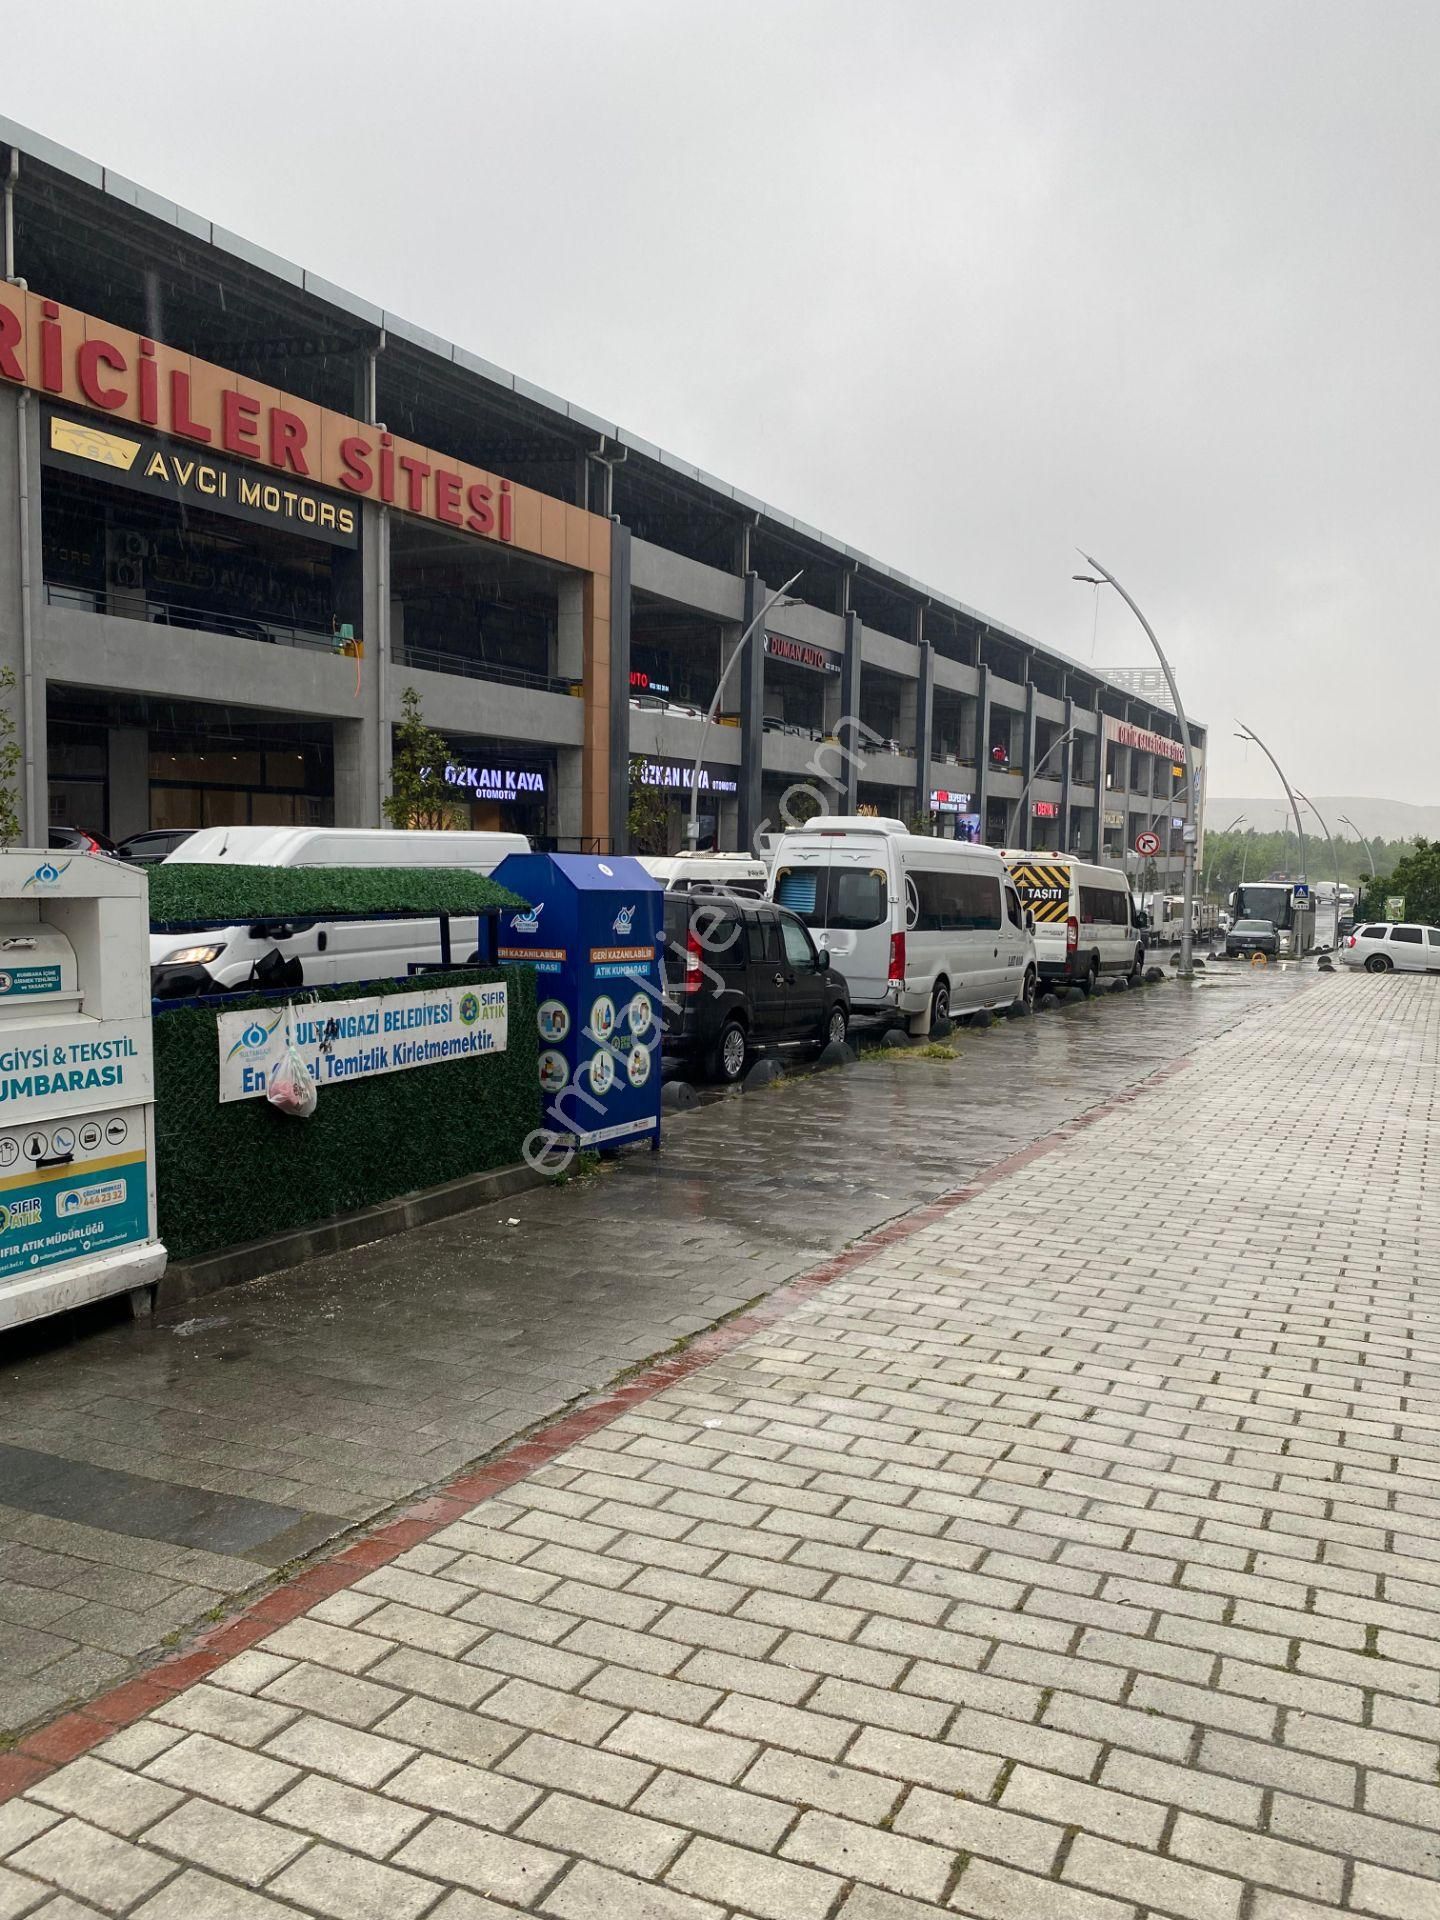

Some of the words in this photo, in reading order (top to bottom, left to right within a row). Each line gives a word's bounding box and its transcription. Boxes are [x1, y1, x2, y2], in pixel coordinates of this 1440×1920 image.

[144, 451, 227, 497] AVCI
[239, 478, 354, 533] MOTORS
[340, 433, 512, 541] SİTESİ
[771, 638, 801, 660] DUMAN
[803, 647, 824, 667] AUTO
[444, 761, 502, 788] ÖZKAN
[506, 770, 544, 791] KAYA
[476, 788, 517, 800] OTOMOTİV
[1028, 889, 1062, 900] TAŞITI
[510, 949, 563, 959] KAZANILABİLİR
[592, 949, 607, 960] GERİ
[608, 948, 652, 959] KAZANILABİLİR
[596, 967, 610, 976] ATIK
[612, 965, 647, 975] KUMBARASI
[481, 991, 505, 1006] SIFIR
[384, 999, 452, 1032] BELEDİYESİ
[482, 1005, 505, 1020] ATIK
[0, 1044, 48, 1072] GİYSİ
[53, 1046, 66, 1066] &
[69, 1035, 138, 1062] TEKSTİL
[243, 1067, 266, 1093] En
[325, 1046, 388, 1078] Temizlik
[393, 1029, 494, 1065] Kirletmemektir.
[101, 1192, 111, 1203] 23
[11, 1199, 41, 1215] SIFIR
[10, 1211, 41, 1229] ATIK
[22, 1238, 44, 1252] ATIK
[46, 1221, 104, 1245] MÜDÜRLÜĞÜ
